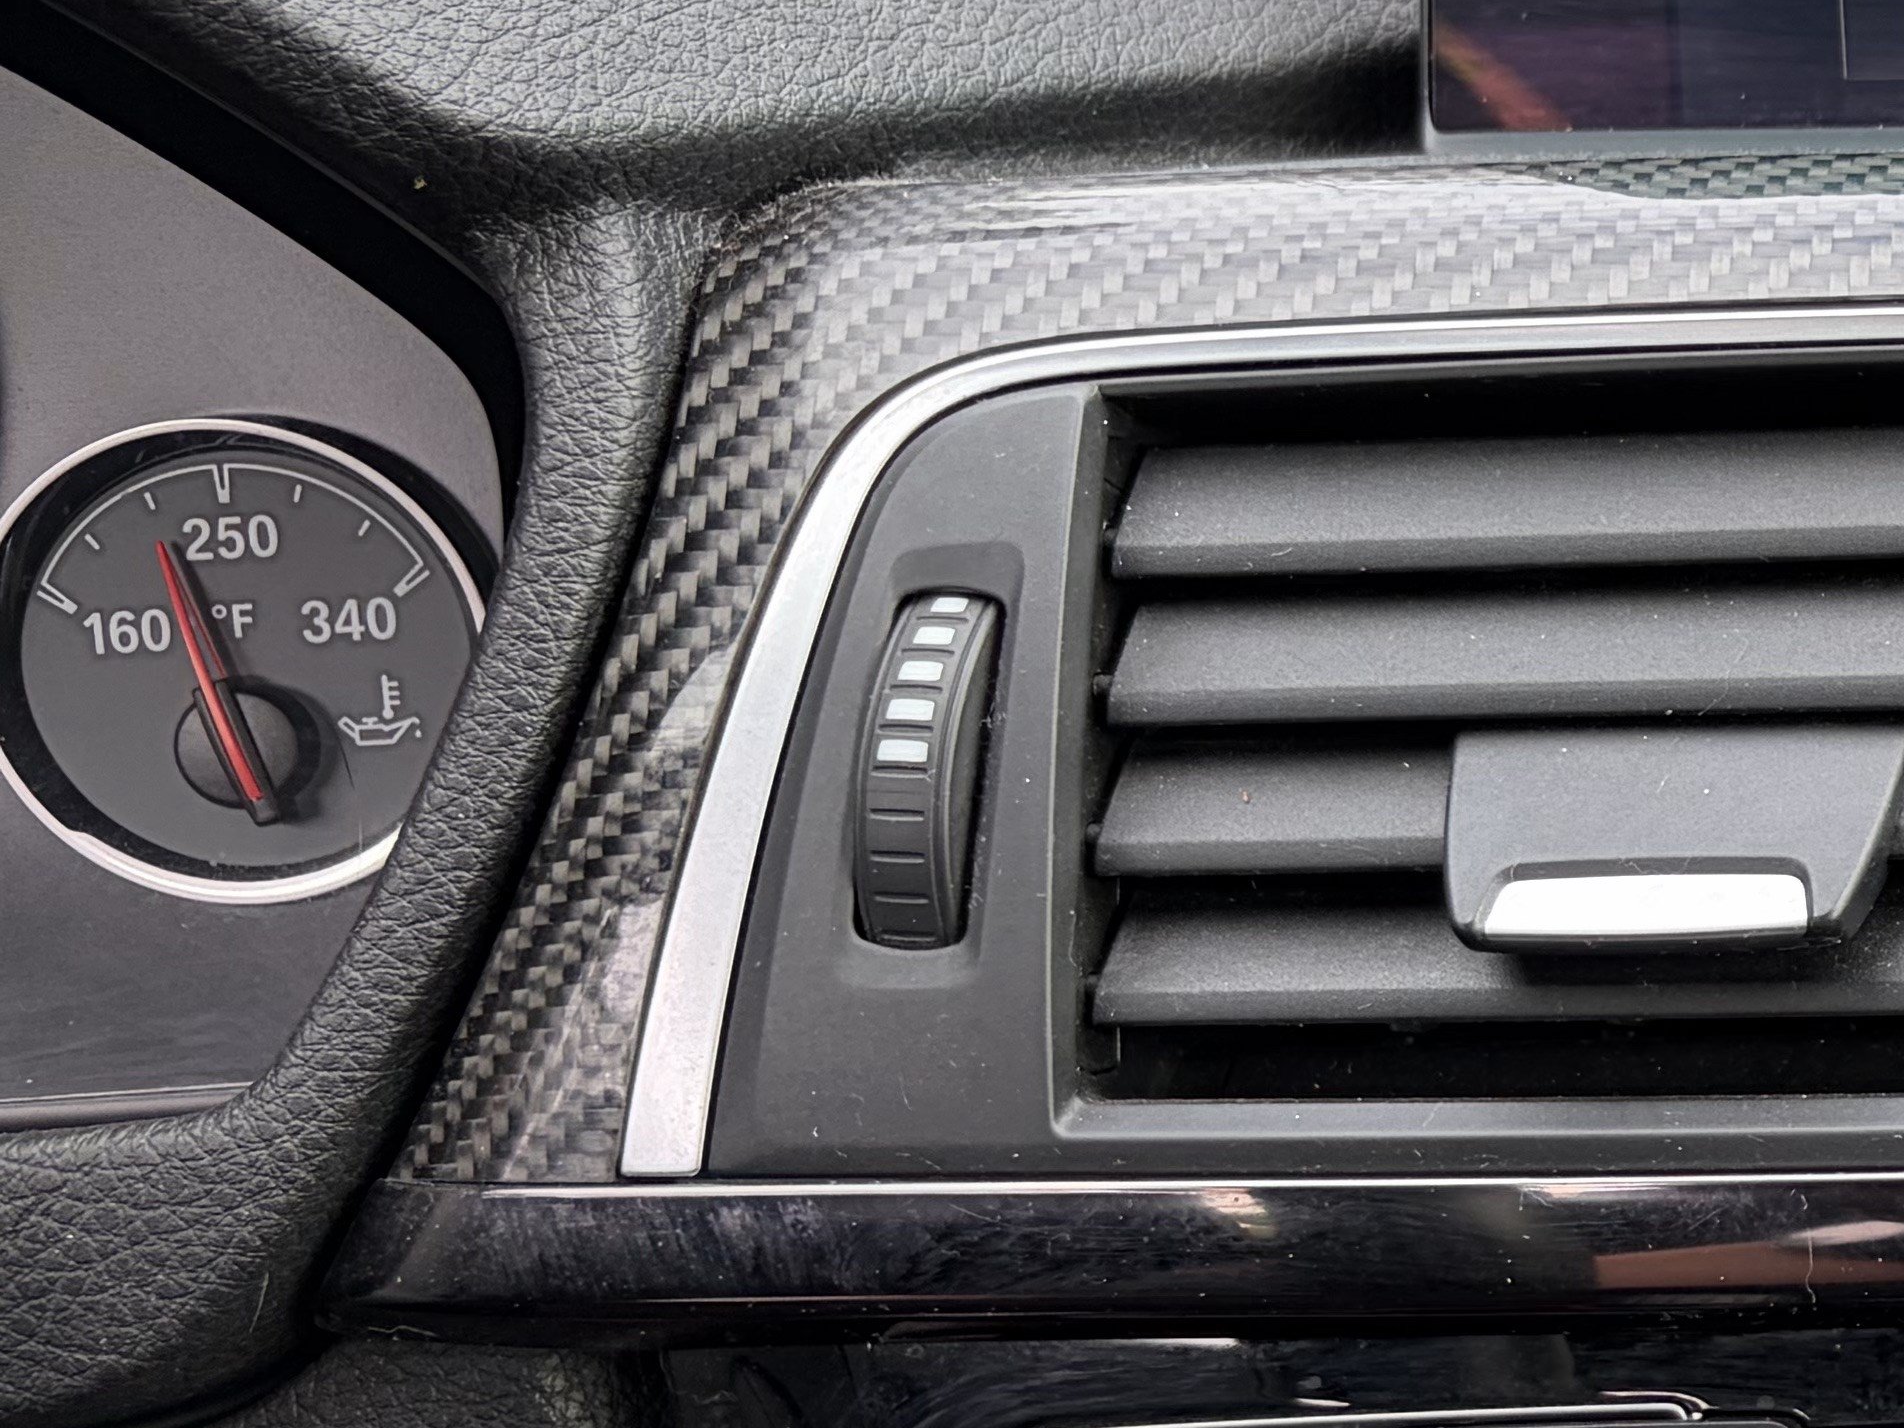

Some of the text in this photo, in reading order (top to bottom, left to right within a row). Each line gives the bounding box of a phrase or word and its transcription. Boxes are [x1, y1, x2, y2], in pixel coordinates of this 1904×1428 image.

[182, 515, 278, 560] 250
[84, 608, 171, 654] 160
[302, 597, 396, 643] 340
